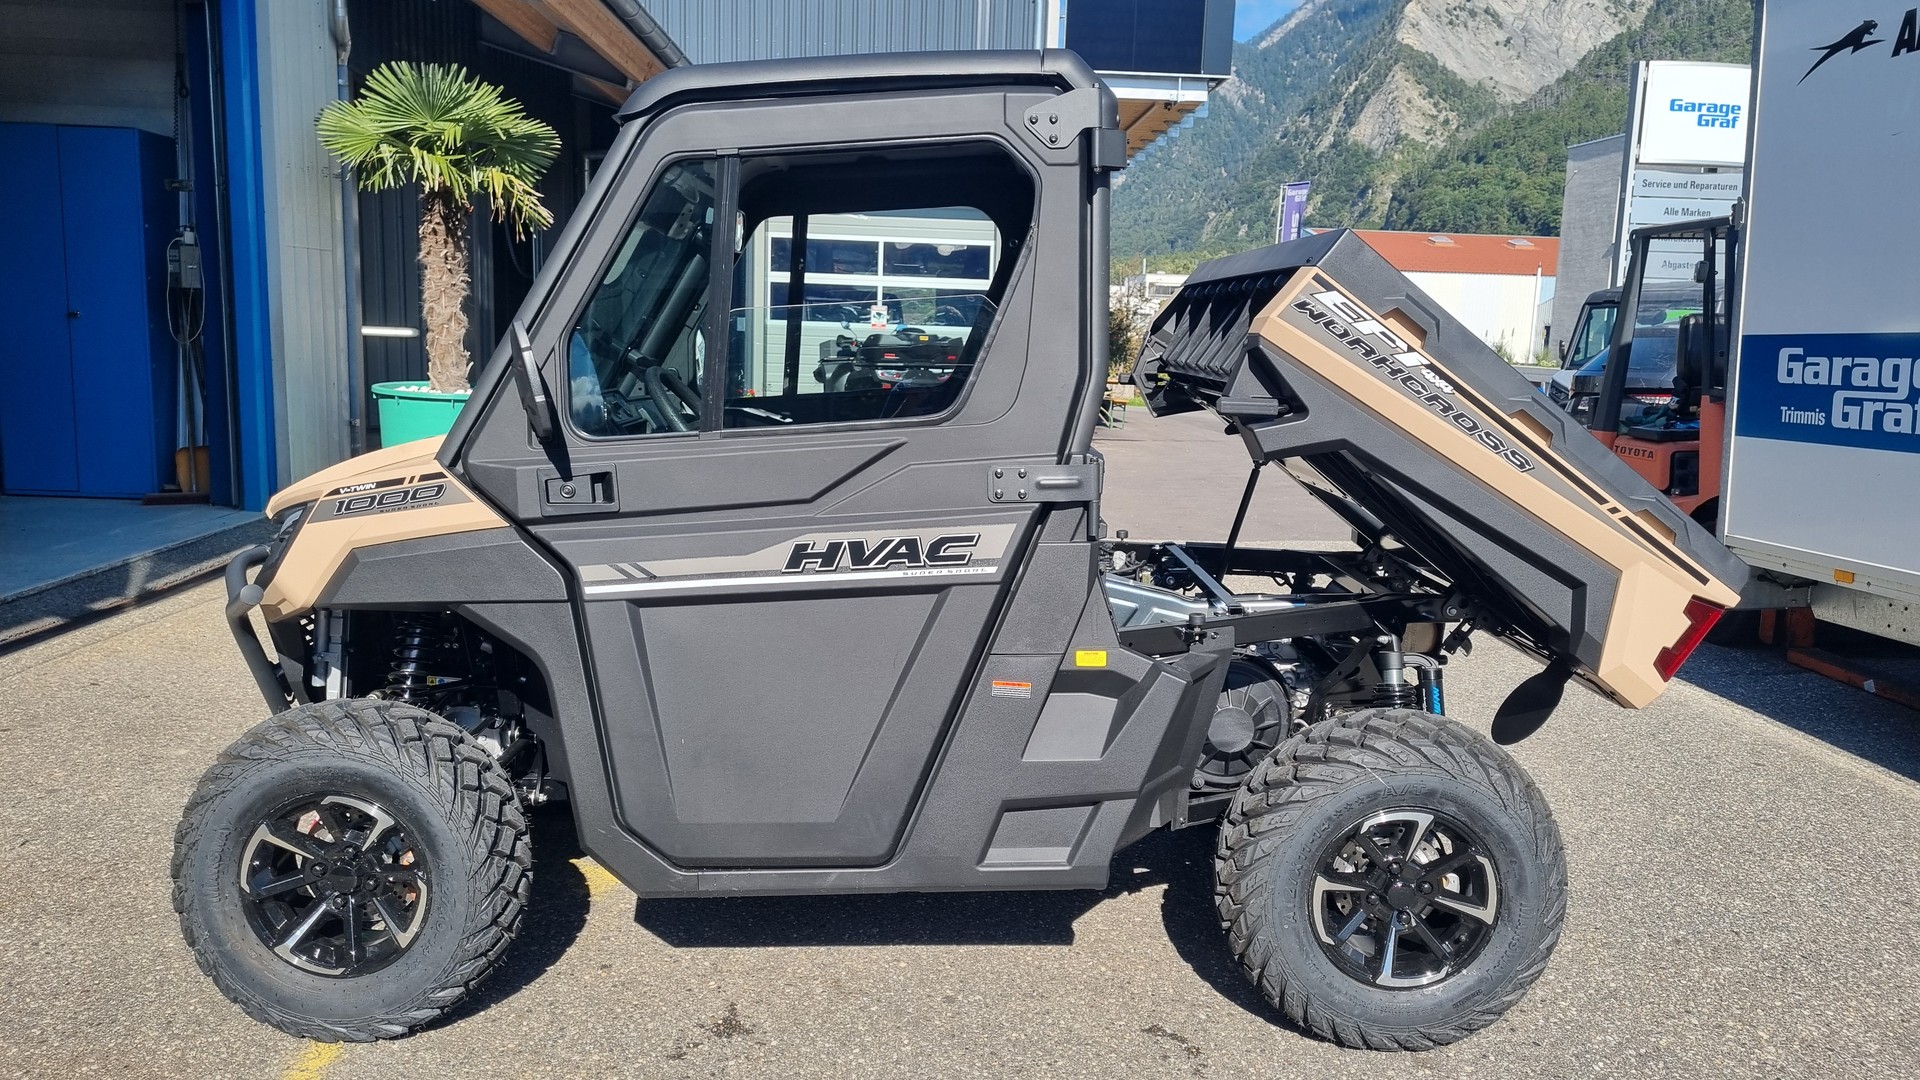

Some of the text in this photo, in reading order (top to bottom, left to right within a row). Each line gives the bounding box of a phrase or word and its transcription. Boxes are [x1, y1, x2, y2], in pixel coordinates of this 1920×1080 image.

[1669, 98, 1742, 117] Garage
[1697, 114, 1740, 129] Graf
[1642, 178, 1738, 191] Service und Reparaturen
[1663, 207, 1711, 217] Alle Marken
[1309, 290, 1432, 368] EFI
[1290, 297, 1536, 474] WORKCROSS
[1777, 347, 1920, 401] Garag
[1780, 389, 1920, 435] Trimmis Gra
[1614, 445, 1655, 460] TOYOTA
[333, 483, 447, 516] 1000
[339, 482, 377, 494] V-TWIN
[780, 532, 982, 575] HVAC
